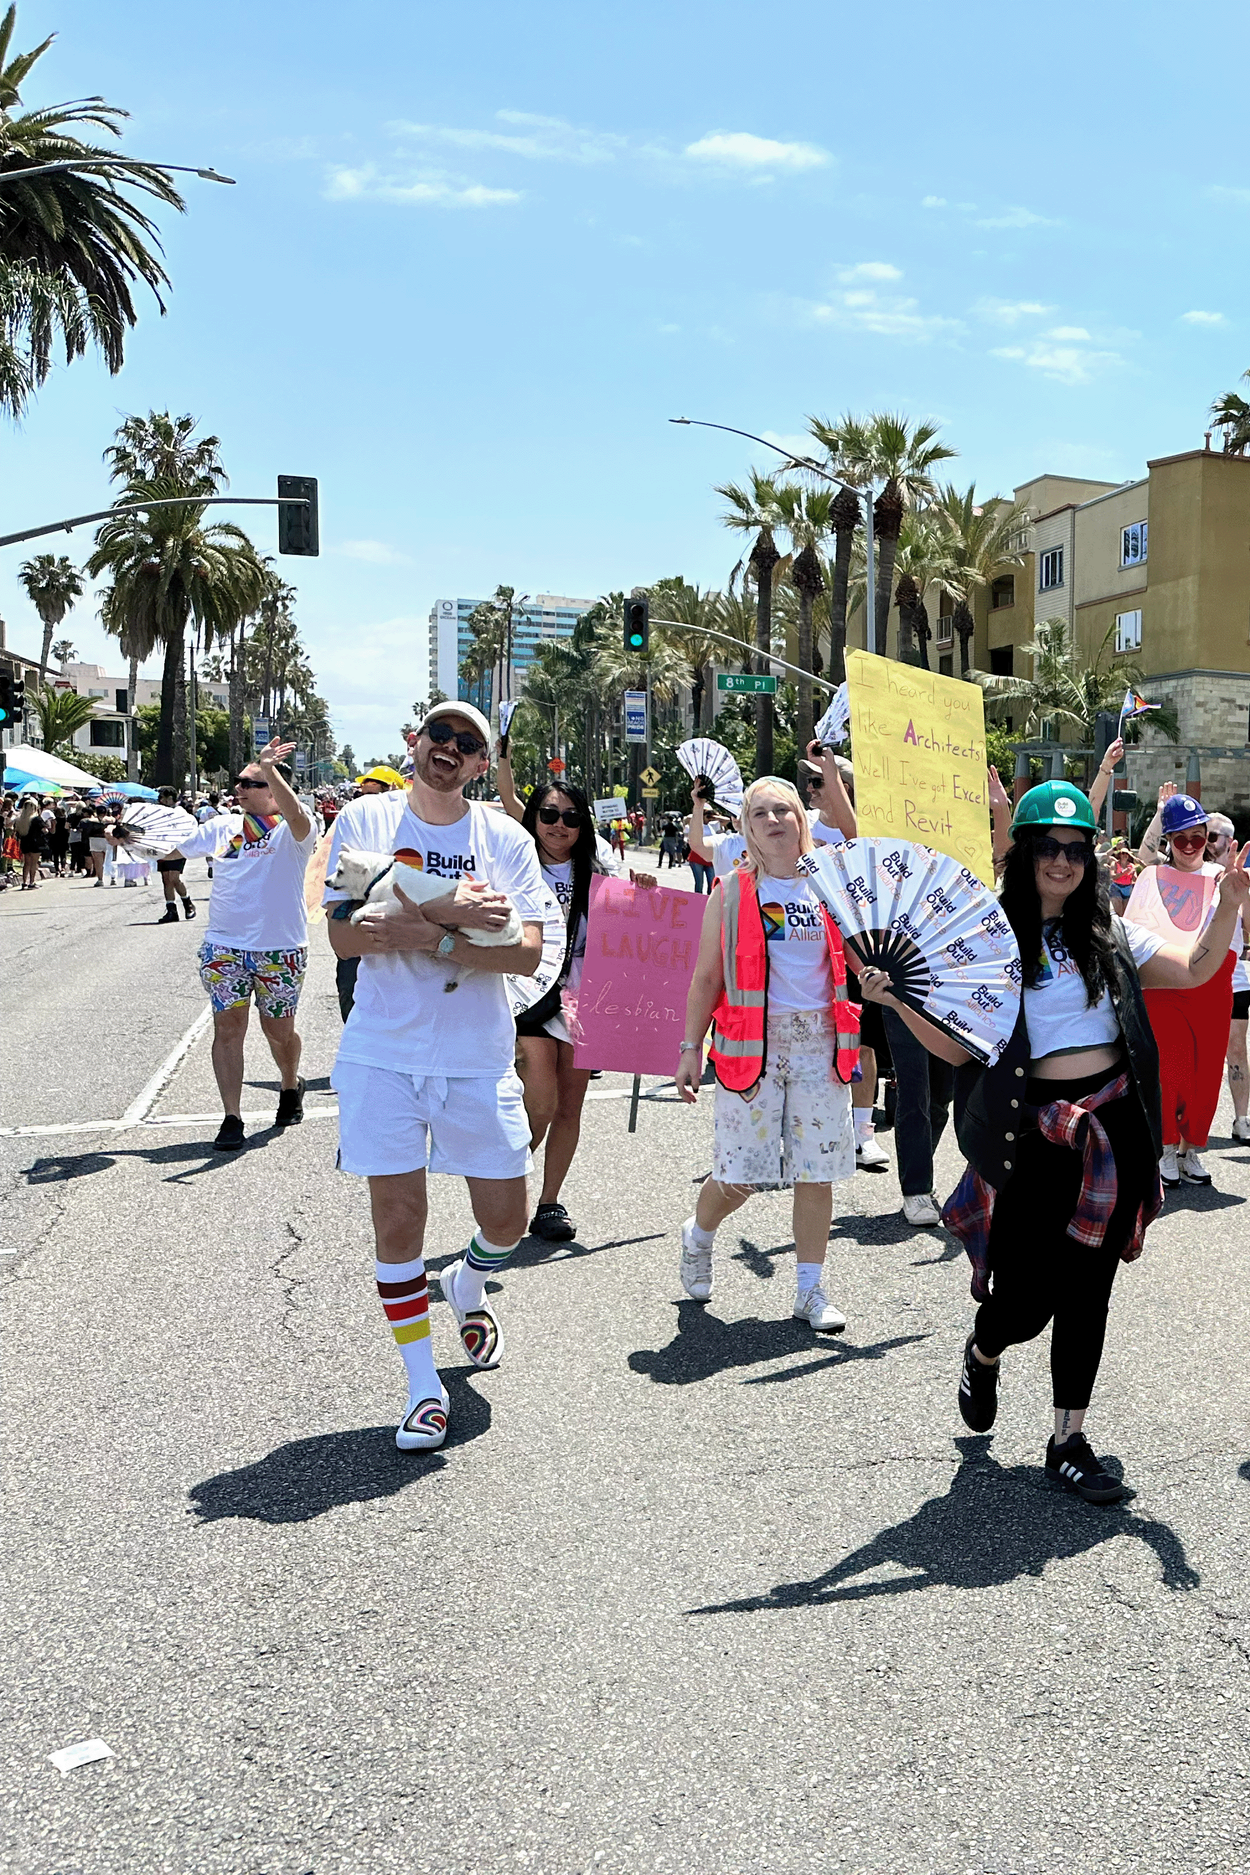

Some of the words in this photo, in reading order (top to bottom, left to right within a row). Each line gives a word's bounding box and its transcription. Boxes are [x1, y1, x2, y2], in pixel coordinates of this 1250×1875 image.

[726, 677, 745, 688] 8th
[755, 681, 766, 690] Pl
[854, 656, 874, 689] I
[886, 664, 935, 705] heard
[944, 697, 971, 721] you
[857, 702, 892, 739] like
[857, 751, 890, 780] Well
[900, 760, 927, 789] I've
[932, 773, 946, 803] got
[953, 774, 986, 806] Excel
[861, 795, 894, 823] and
[904, 799, 953, 837] Revit
[426, 850, 476, 872] Build
[801, 854, 820, 874] uild
[882, 857, 899, 879] Out
[889, 850, 913, 879] Build
[853, 875, 878, 904] Build
[960, 867, 978, 888] Out
[846, 882, 863, 905] Out
[926, 893, 943, 914] Out
[933, 887, 957, 914] Build
[604, 888, 689, 929] LIVE
[788, 914, 817, 928] Out
[898, 913, 922, 940] Build
[981, 916, 998, 937] Out
[988, 909, 1011, 935] Build
[789, 927, 827, 941] Allian
[601, 932, 692, 971] LAUGH
[946, 944, 964, 963] Out
[954, 937, 978, 961] Build
[1004, 964, 1022, 984] Out
[589, 980, 680, 1022] lesbian
[971, 991, 990, 1010] Out
[978, 984, 1004, 1009] Build
